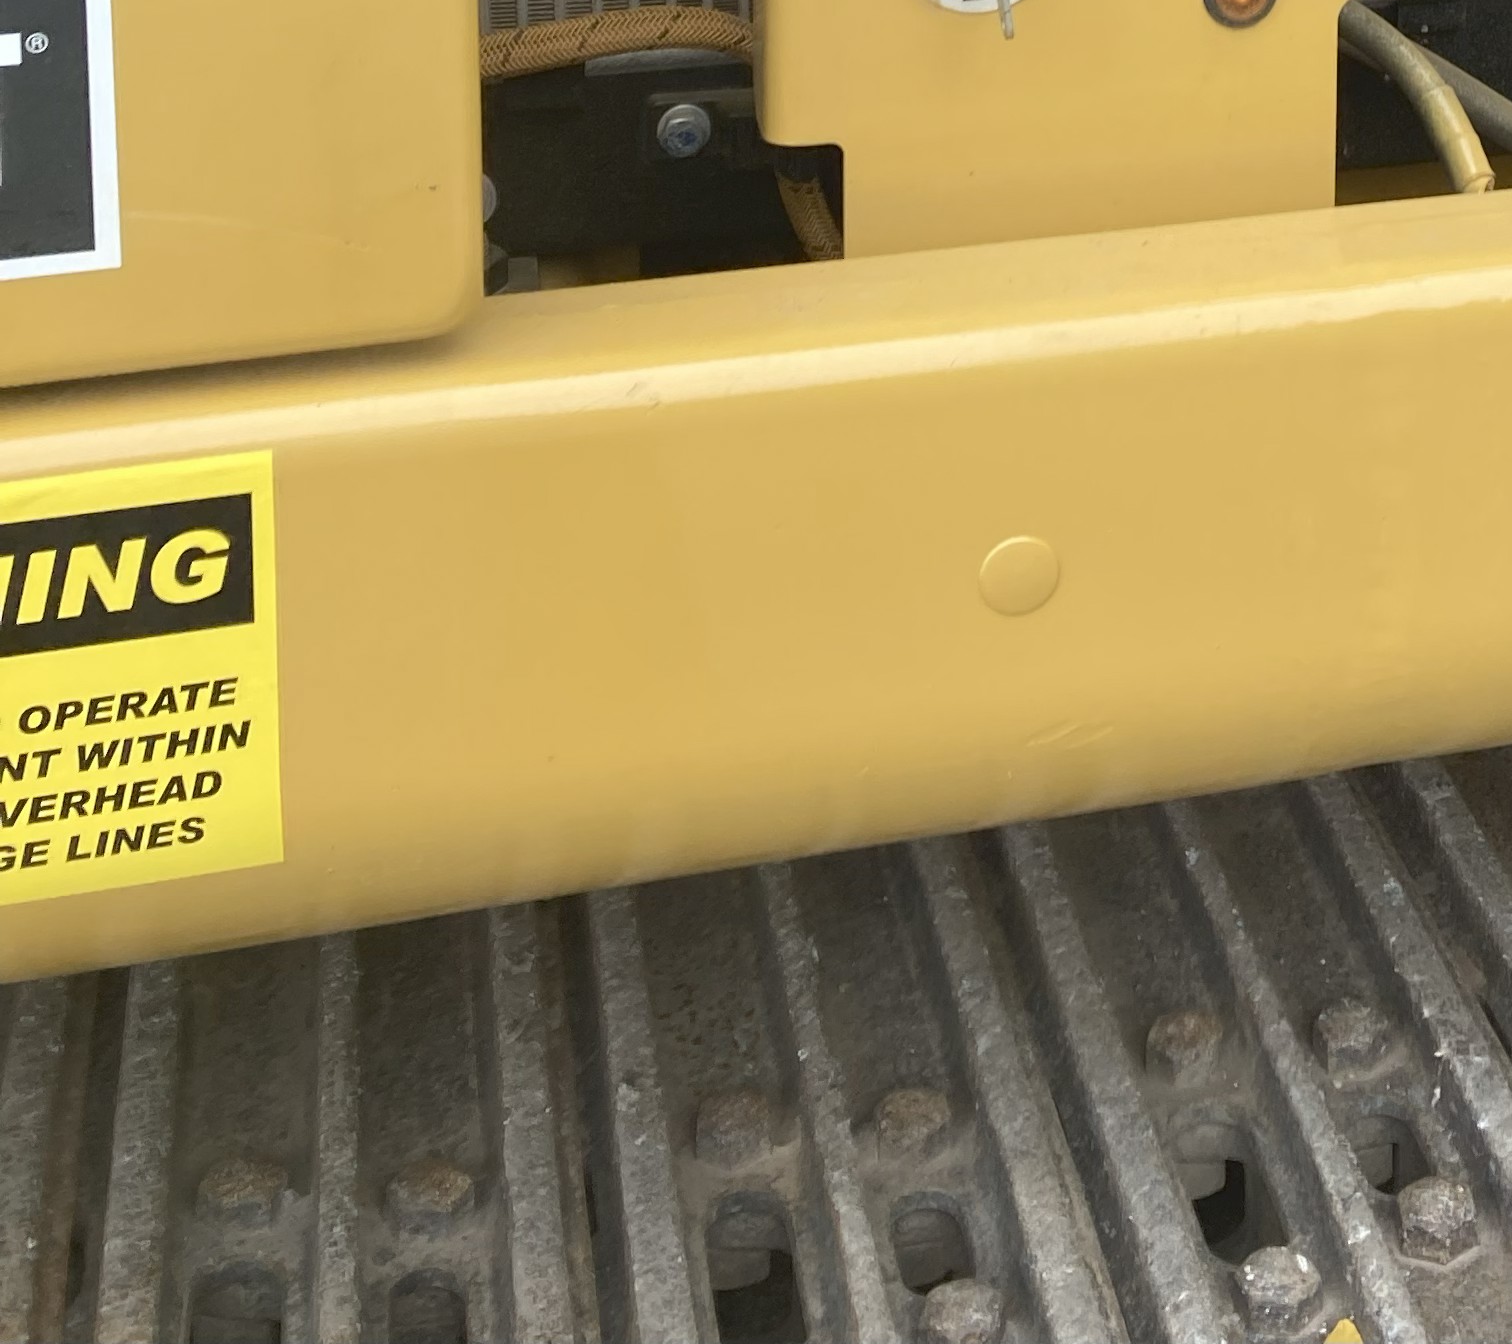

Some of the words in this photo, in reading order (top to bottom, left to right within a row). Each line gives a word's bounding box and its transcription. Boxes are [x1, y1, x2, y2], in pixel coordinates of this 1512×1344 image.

[0, 528, 230, 625] ING
[18, 676, 239, 734] OPERATE
[77, 719, 251, 772] WITHIN
[65, 816, 206, 862] LINES
